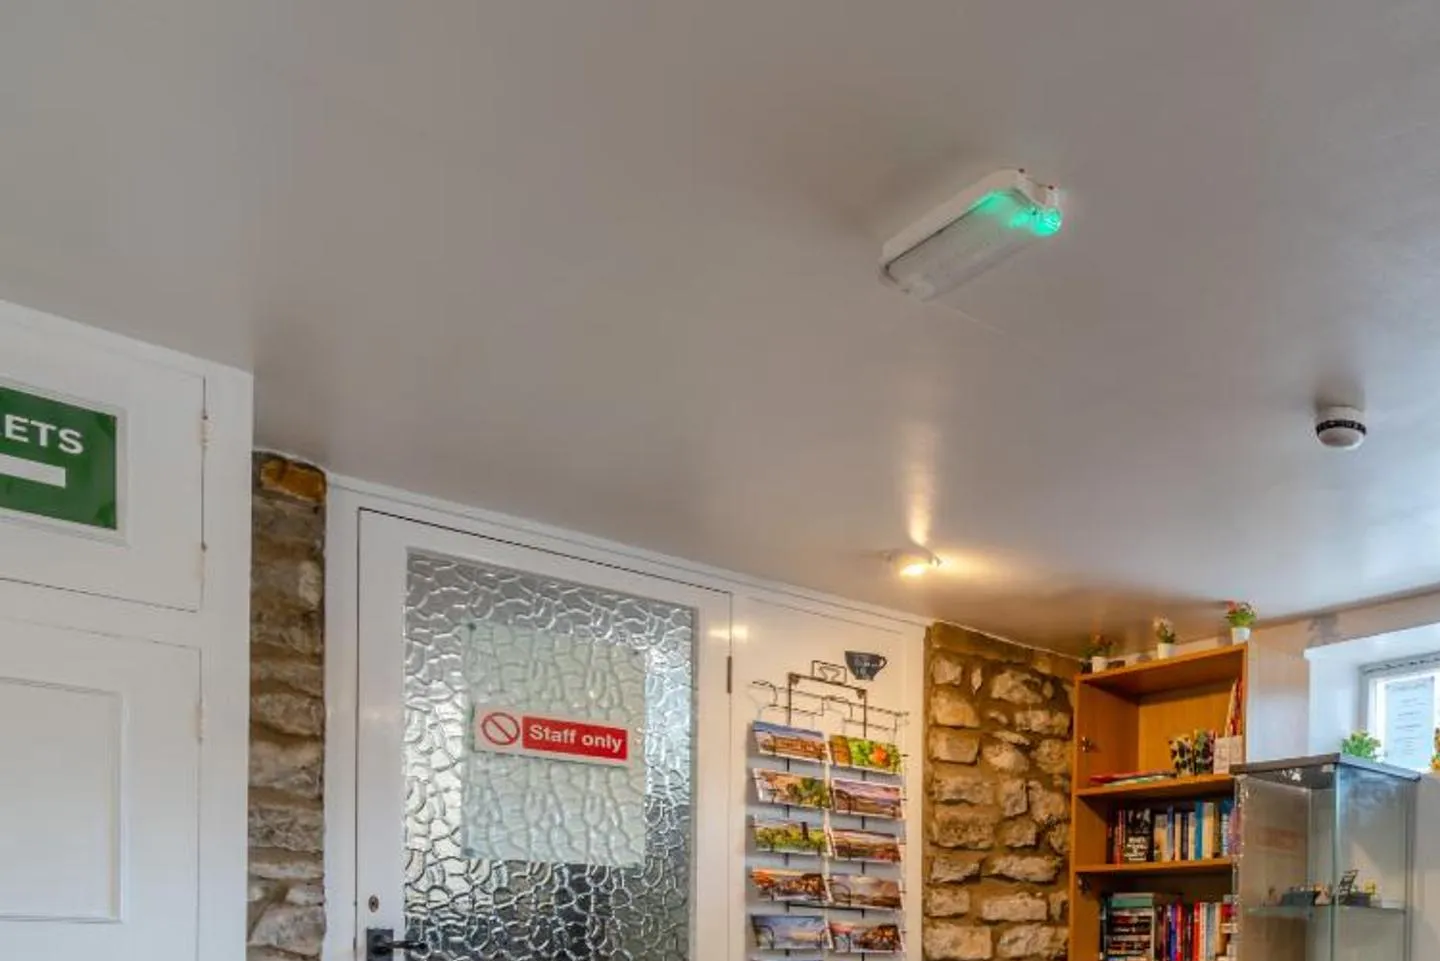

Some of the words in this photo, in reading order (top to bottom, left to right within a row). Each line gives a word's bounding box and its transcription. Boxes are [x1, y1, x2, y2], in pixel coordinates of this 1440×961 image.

[0, 414, 84, 454] ETS
[529, 723, 577, 744] Staff
[581, 734, 622, 754] only
